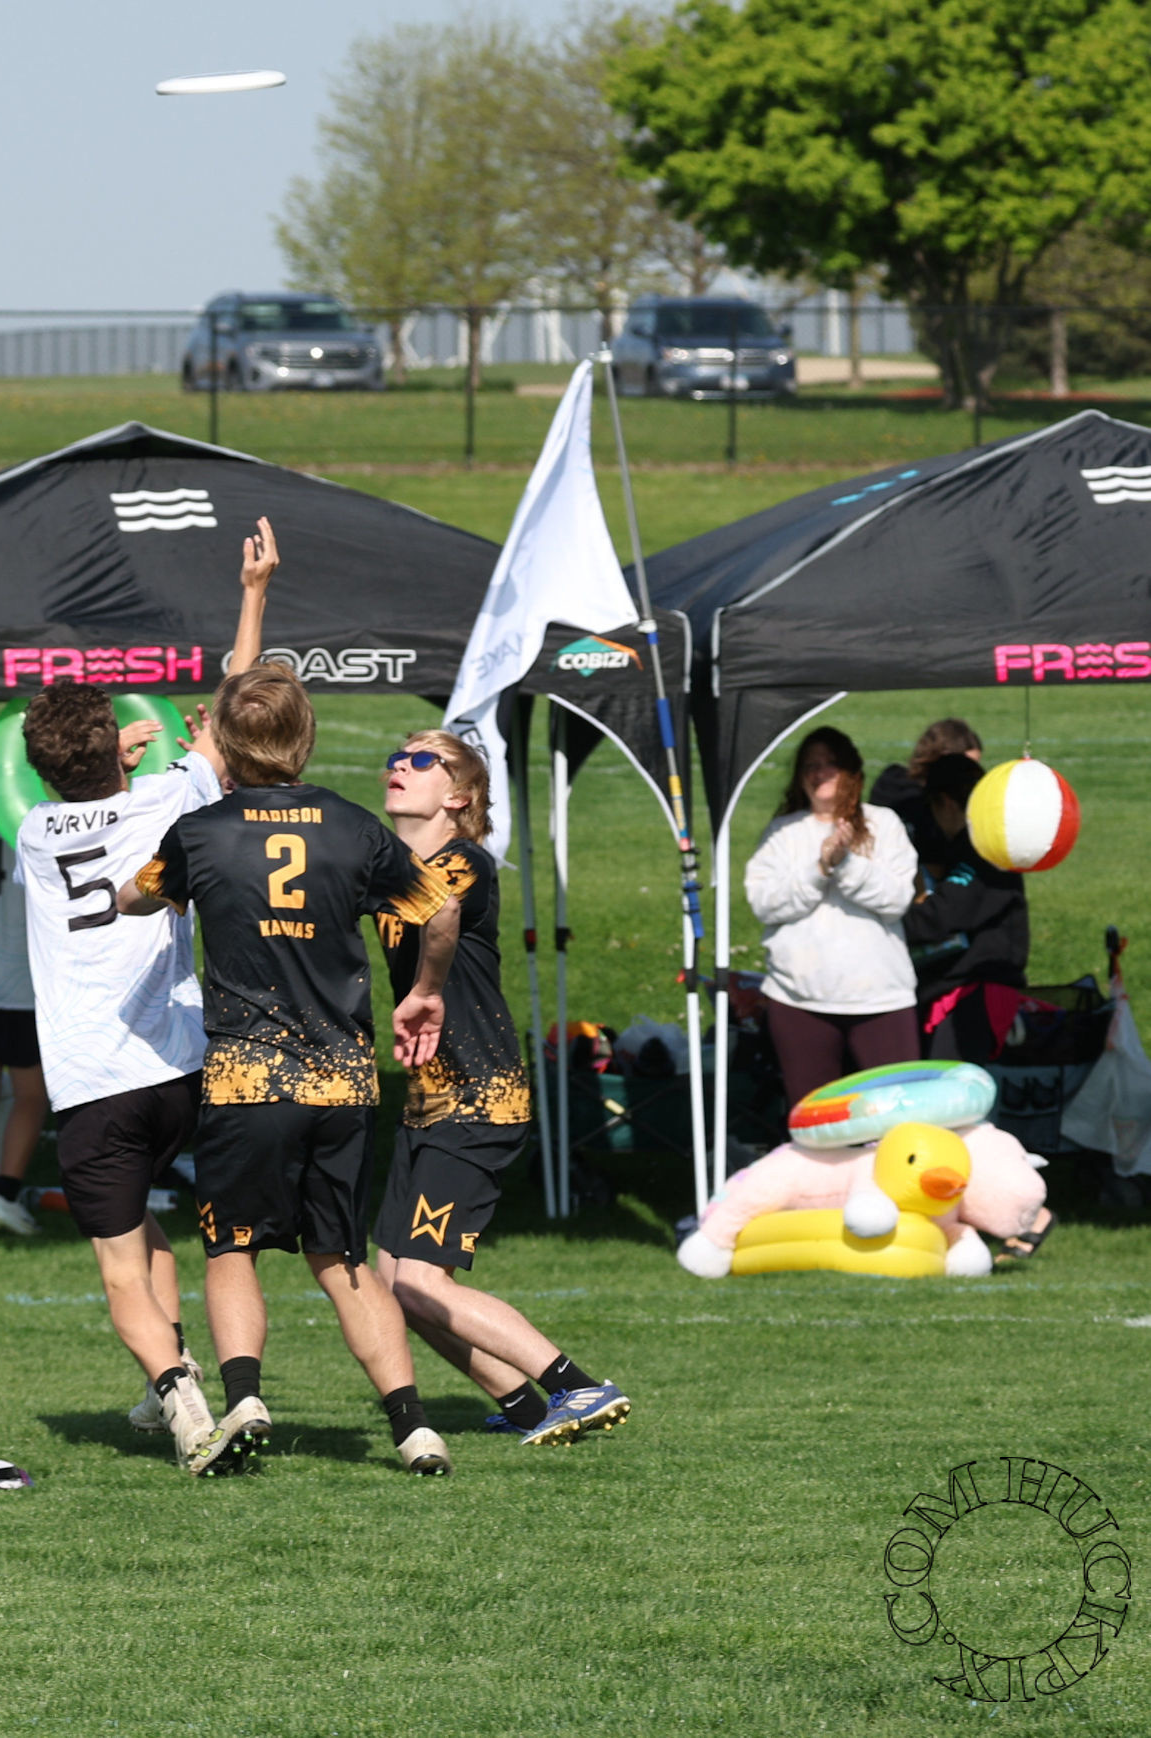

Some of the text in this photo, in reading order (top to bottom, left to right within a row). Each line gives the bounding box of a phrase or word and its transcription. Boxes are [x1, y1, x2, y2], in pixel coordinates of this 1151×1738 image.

[558, 652, 630, 670] COBIZI
[243, 807, 322, 824] MADISON
[54, 845, 118, 932] 5
[265, 833, 306, 909] 2
